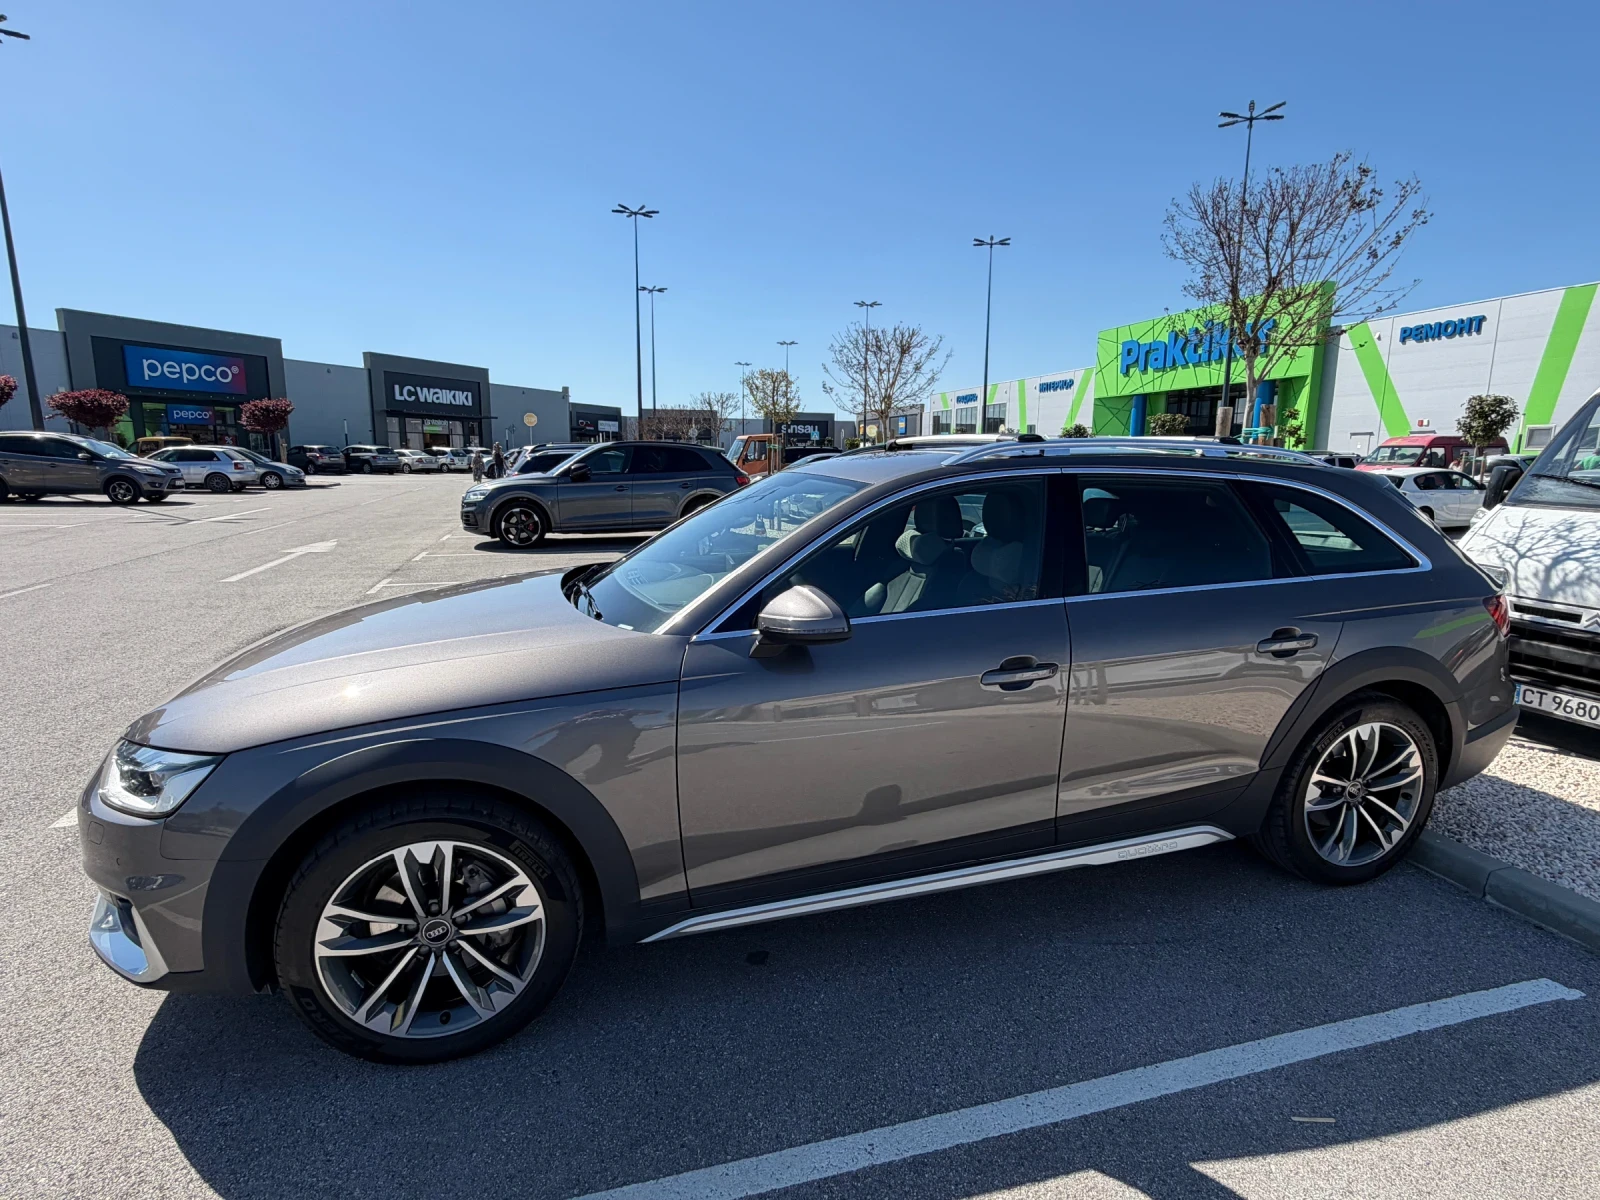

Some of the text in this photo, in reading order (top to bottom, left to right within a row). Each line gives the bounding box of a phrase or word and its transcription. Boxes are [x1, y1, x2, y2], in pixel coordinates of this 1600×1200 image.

[1399, 315, 1487, 344] РЕМОНТ
[394, 384, 416, 401] LC
[1522, 688, 1600, 720] CT 9680
[509, 839, 551, 879] PIRELLI
